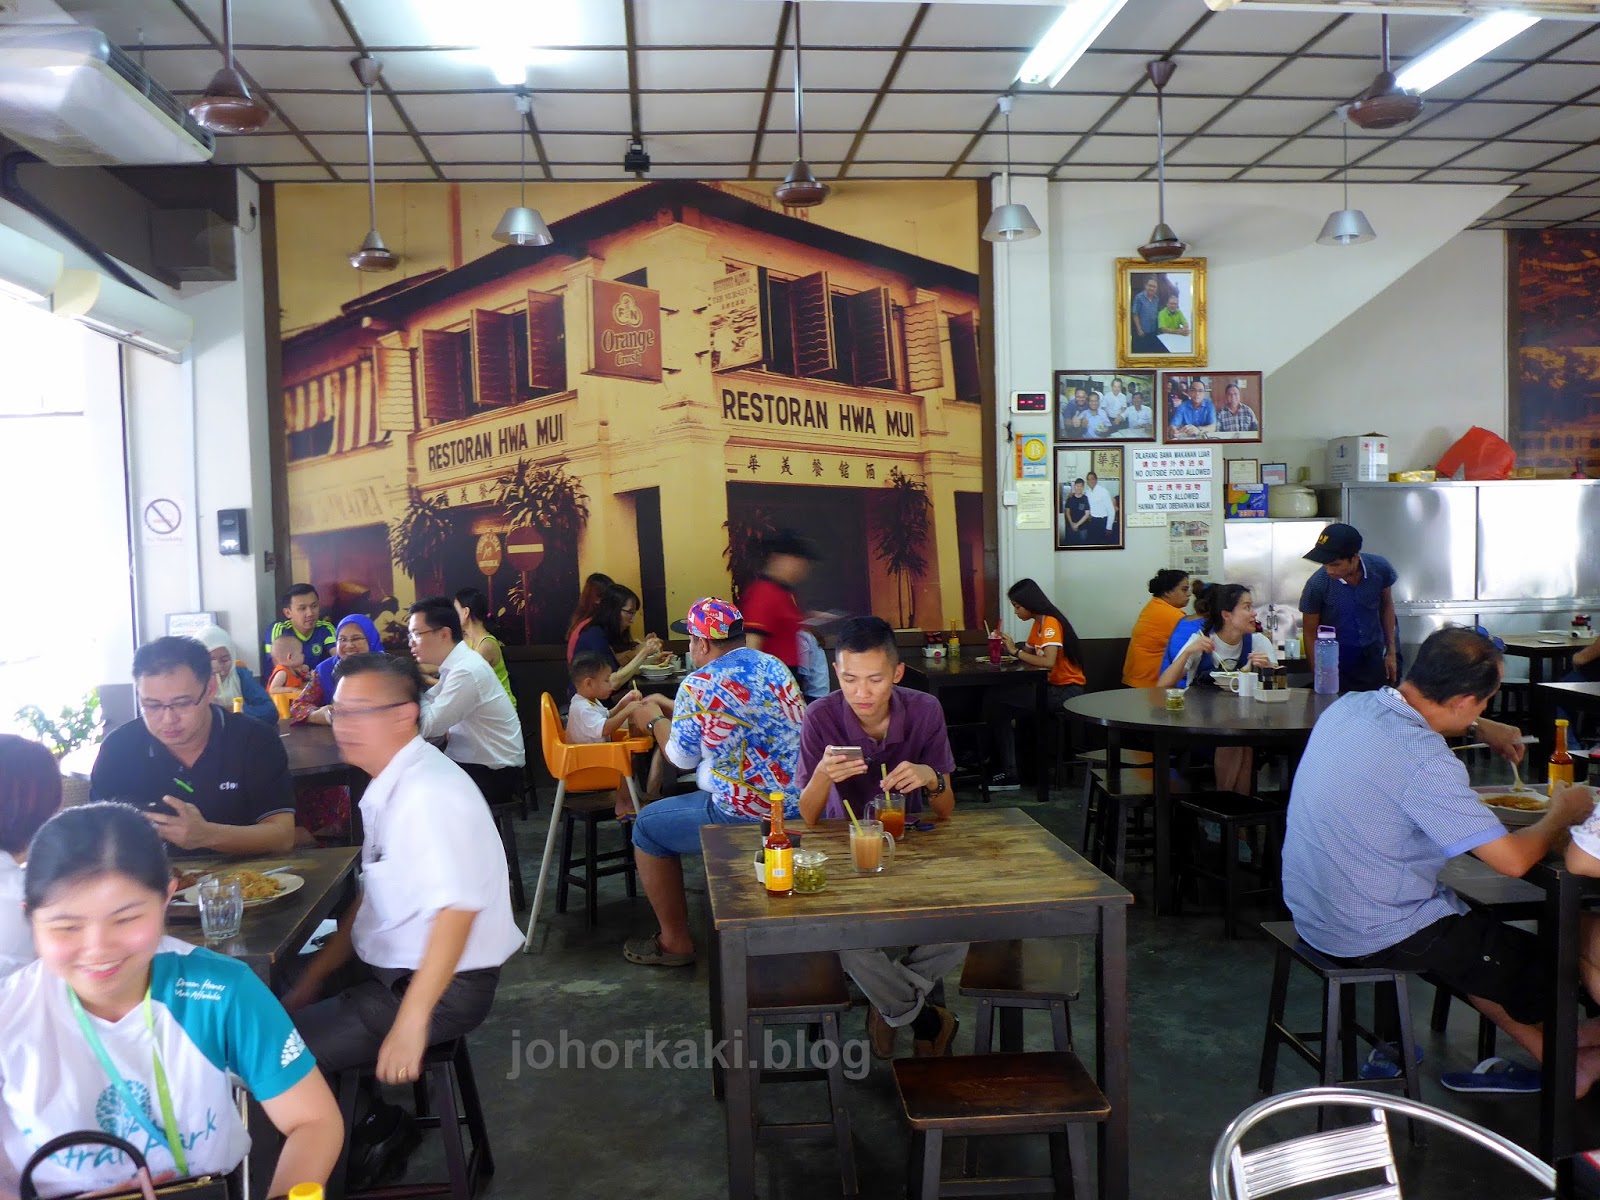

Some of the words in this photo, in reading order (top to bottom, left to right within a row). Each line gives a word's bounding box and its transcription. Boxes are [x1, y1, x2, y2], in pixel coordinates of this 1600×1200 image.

[602, 329, 655, 353] Orange
[615, 350, 643, 367] Crush
[722, 389, 829, 430] RESTORAN
[839, 403, 876, 434] HWA
[886, 409, 915, 438] MUI
[428, 431, 492, 471] RESTORAN
[498, 423, 528, 455] HWA
[536, 413, 563, 446] MUI
[1135, 451, 1158, 460] DILARANG
[1160, 451, 1172, 459] BAWA
[1174, 450, 1197, 458] MAKANAN
[1198, 450, 1211, 458] LUAR
[1135, 469, 1144, 477] NO
[1145, 469, 1168, 477] OUTSIDE
[1169, 468, 1185, 476] FOOD
[1186, 468, 1211, 476] ALLOWED
[1149, 493, 1158, 501] NO
[1159, 493, 1173, 501] PETS
[1174, 492, 1200, 500] ALLOWED
[1155, 502, 1168, 510] TIDAK
[1196, 501, 1211, 509] MASUK
